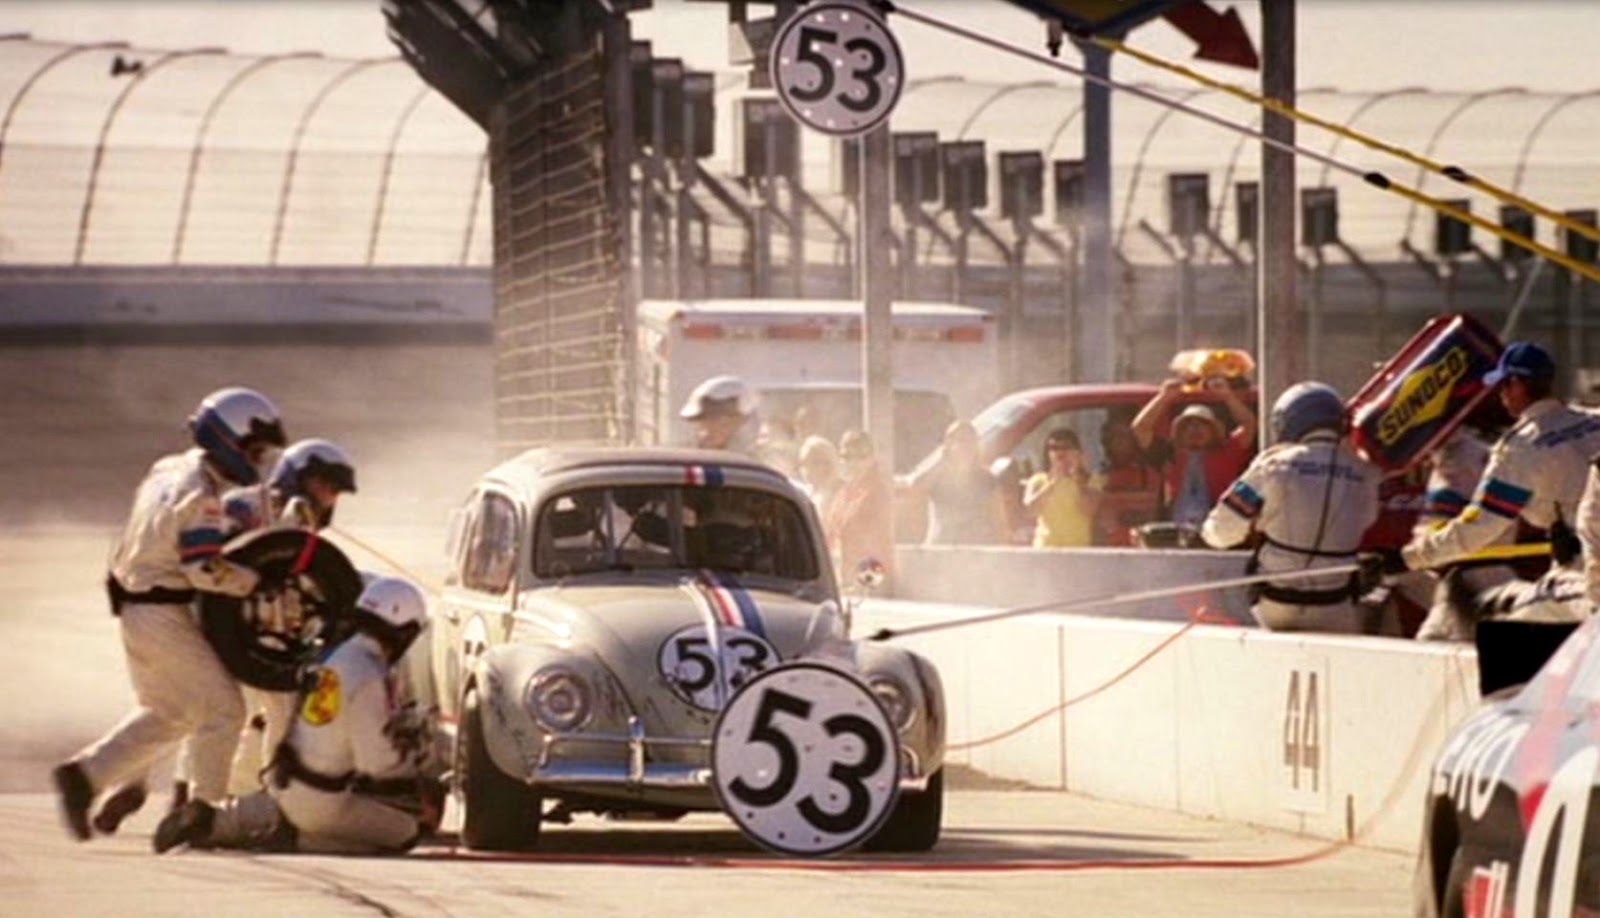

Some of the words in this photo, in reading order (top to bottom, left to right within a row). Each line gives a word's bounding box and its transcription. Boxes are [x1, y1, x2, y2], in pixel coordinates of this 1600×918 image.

[789, 27, 886, 113] 53
[1382, 351, 1463, 439] SUNOCO
[675, 637, 768, 692] 53
[728, 688, 887, 835] 53
